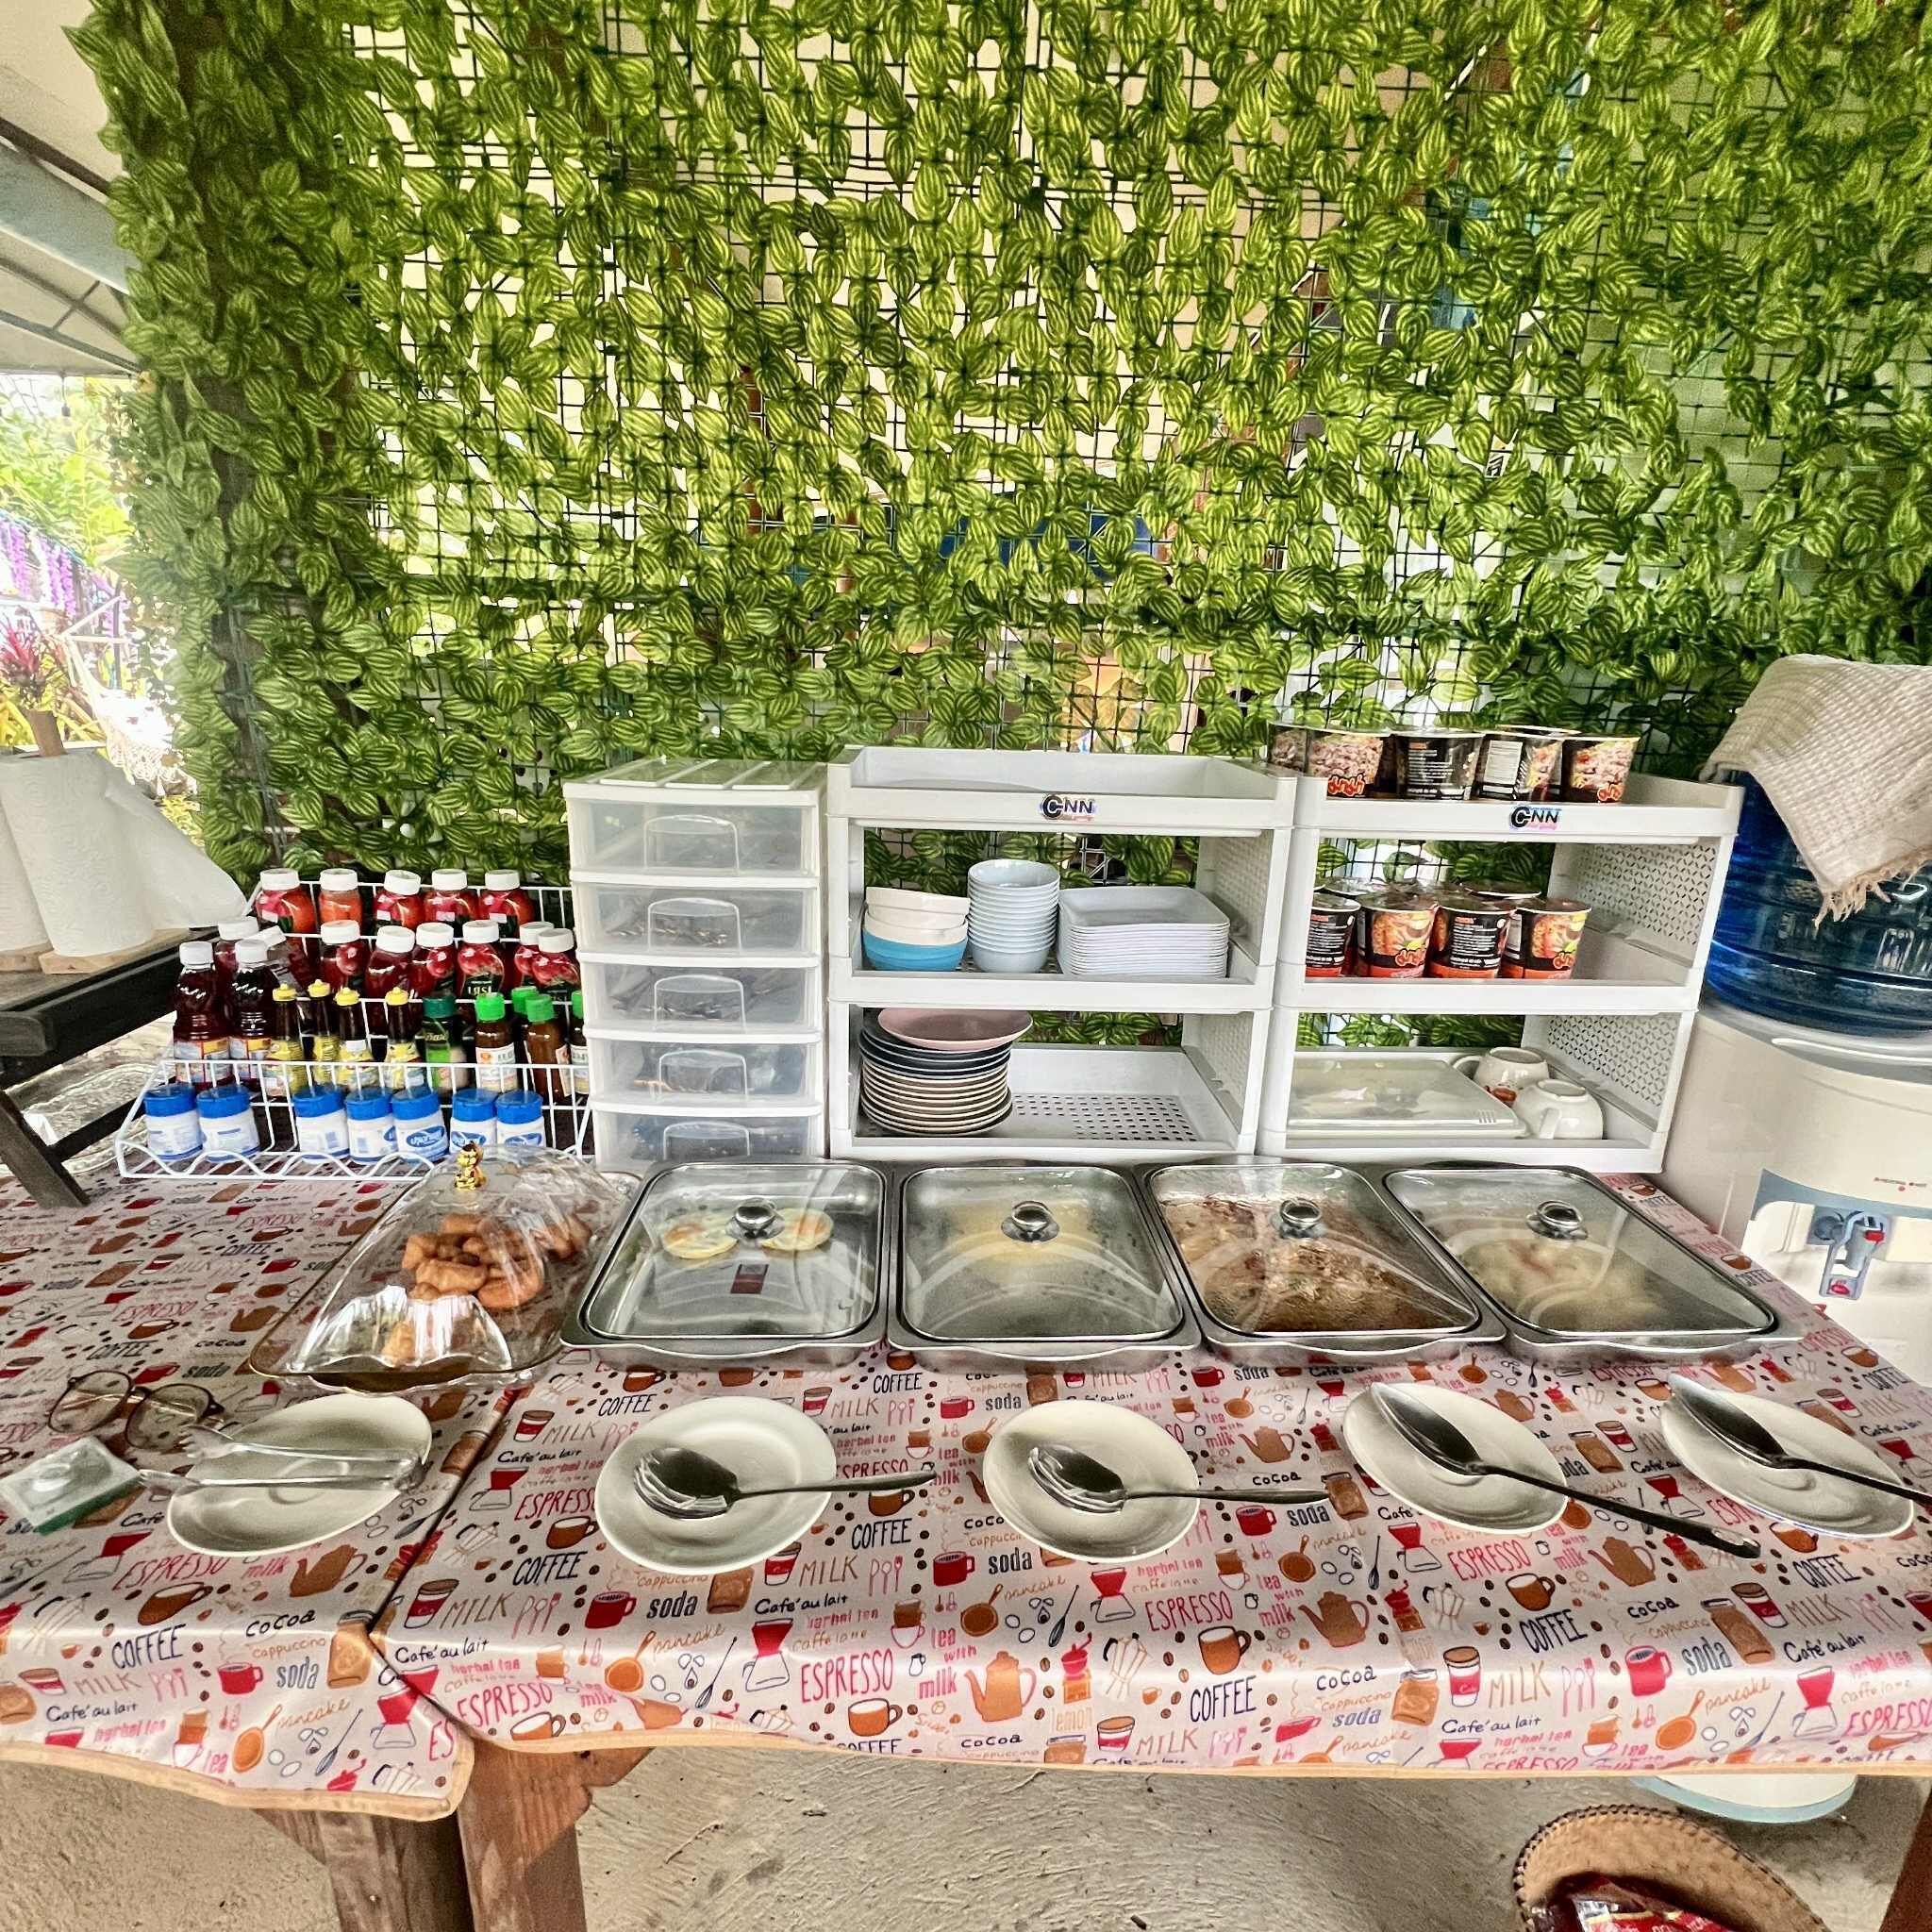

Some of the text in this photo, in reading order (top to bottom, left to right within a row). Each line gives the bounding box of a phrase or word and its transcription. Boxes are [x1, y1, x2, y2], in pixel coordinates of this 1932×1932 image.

[873, 1373, 924, 1394] COFFEE
[1234, 1367, 1269, 1381] soda
[598, 1393, 657, 1417] COFFEE
[830, 1397, 879, 1420] MILK
[985, 1393, 1022, 1410] soda
[541, 1421, 596, 1445] MILK
[1205, 1433, 1236, 1449] milk
[1252, 1472, 1303, 1486] cocoa
[1564, 1458, 1590, 1476] oda
[515, 1488, 595, 1521] ESPRESS
[1288, 1506, 1329, 1526] soda
[852, 1518, 912, 1550] COFFEE
[964, 1515, 1005, 1530] coco
[112, 1553, 230, 1591] ESPRESSO
[512, 1552, 588, 1586] COFFEE
[800, 1555, 859, 1587] MILK
[989, 1547, 1032, 1575] soda
[1448, 1540, 1531, 1582] ESPRESSO
[1555, 1548, 1588, 1570] milk
[1792, 1554, 1860, 1589] COFFEE
[1257, 1574, 1281, 1591] tea
[440, 1592, 515, 1630] MILK
[646, 1590, 698, 1620] soda
[801, 1602, 821, 1610] au
[823, 1592, 849, 1606] lait
[1145, 1591, 1233, 1632] ESPRESSO
[1258, 1604, 1295, 1626] milk
[1626, 1597, 1680, 1619] cocoa
[1786, 1592, 1852, 1629] MILK
[245, 1609, 316, 1638] cocoa
[931, 1627, 957, 1648] tea
[1519, 1609, 1588, 1653] COFFEE
[112, 1624, 186, 1669] COFFEE
[441, 1647, 458, 1657] au
[462, 1637, 490, 1655] lait
[1681, 1636, 1732, 1676] soda
[75, 1673, 142, 1695] MILK
[276, 1657, 318, 1690] soda
[801, 1649, 894, 1703] ESPRESSO
[919, 1667, 957, 1698] milk
[1316, 1666, 1376, 1690] cocoa
[1489, 1661, 1552, 1708] MILK
[457, 1681, 554, 1728] ESPRESSO
[1191, 1675, 1257, 1723] COFFEE
[1705, 1677, 1772, 1715] pancake
[1333, 1707, 1382, 1728] soda
[1491, 1722, 1511, 1731] au
[1515, 1716, 1541, 1729] lait
[1136, 1728, 1198, 1756] MILK
